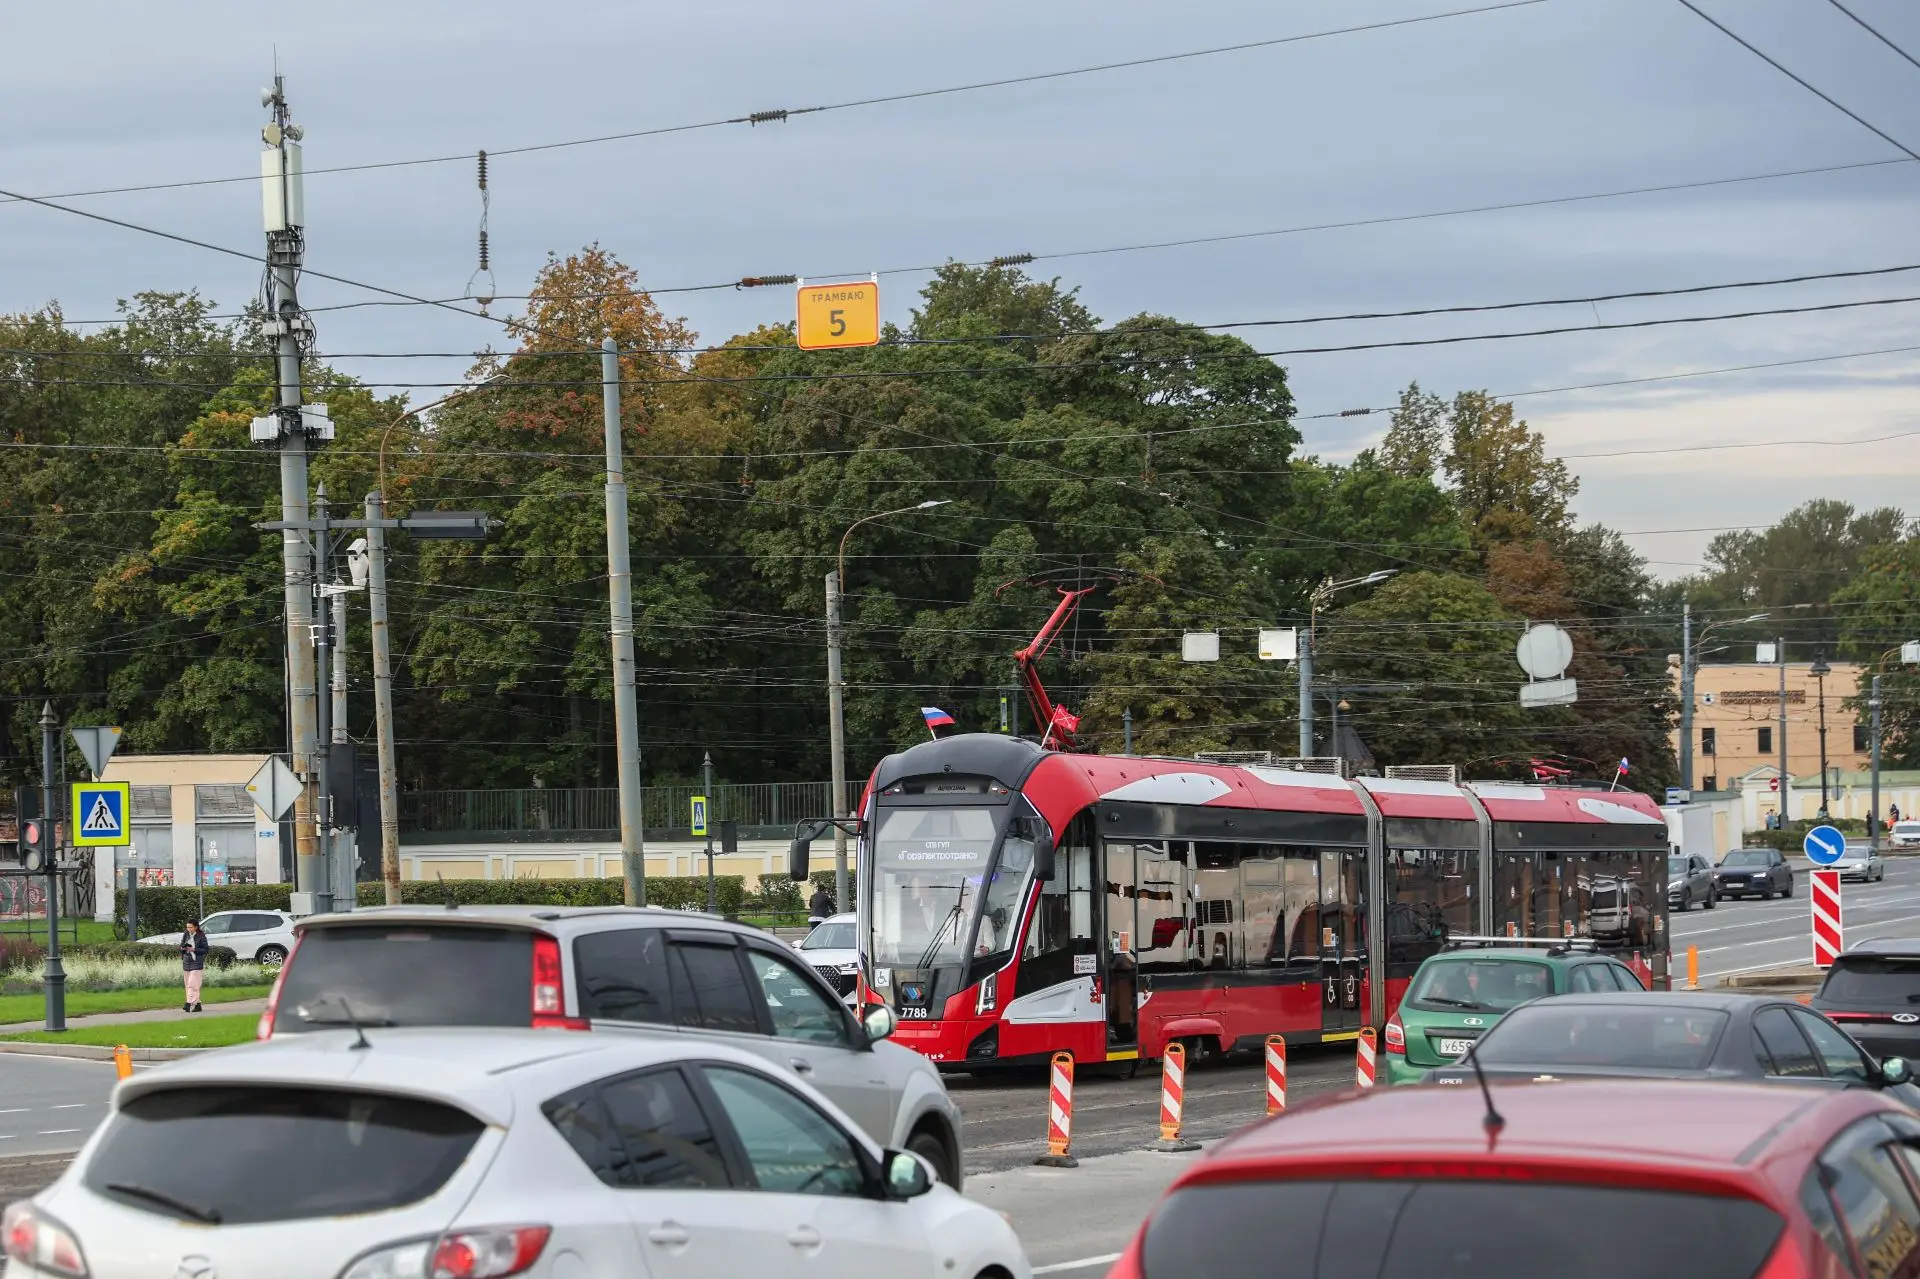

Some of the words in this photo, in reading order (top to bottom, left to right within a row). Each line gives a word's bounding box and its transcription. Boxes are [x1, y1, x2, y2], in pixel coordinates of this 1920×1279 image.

[812, 291, 864, 302] ТРАМВАЮ
[830, 310, 846, 336] 5
[901, 1007, 927, 1018] 7788
